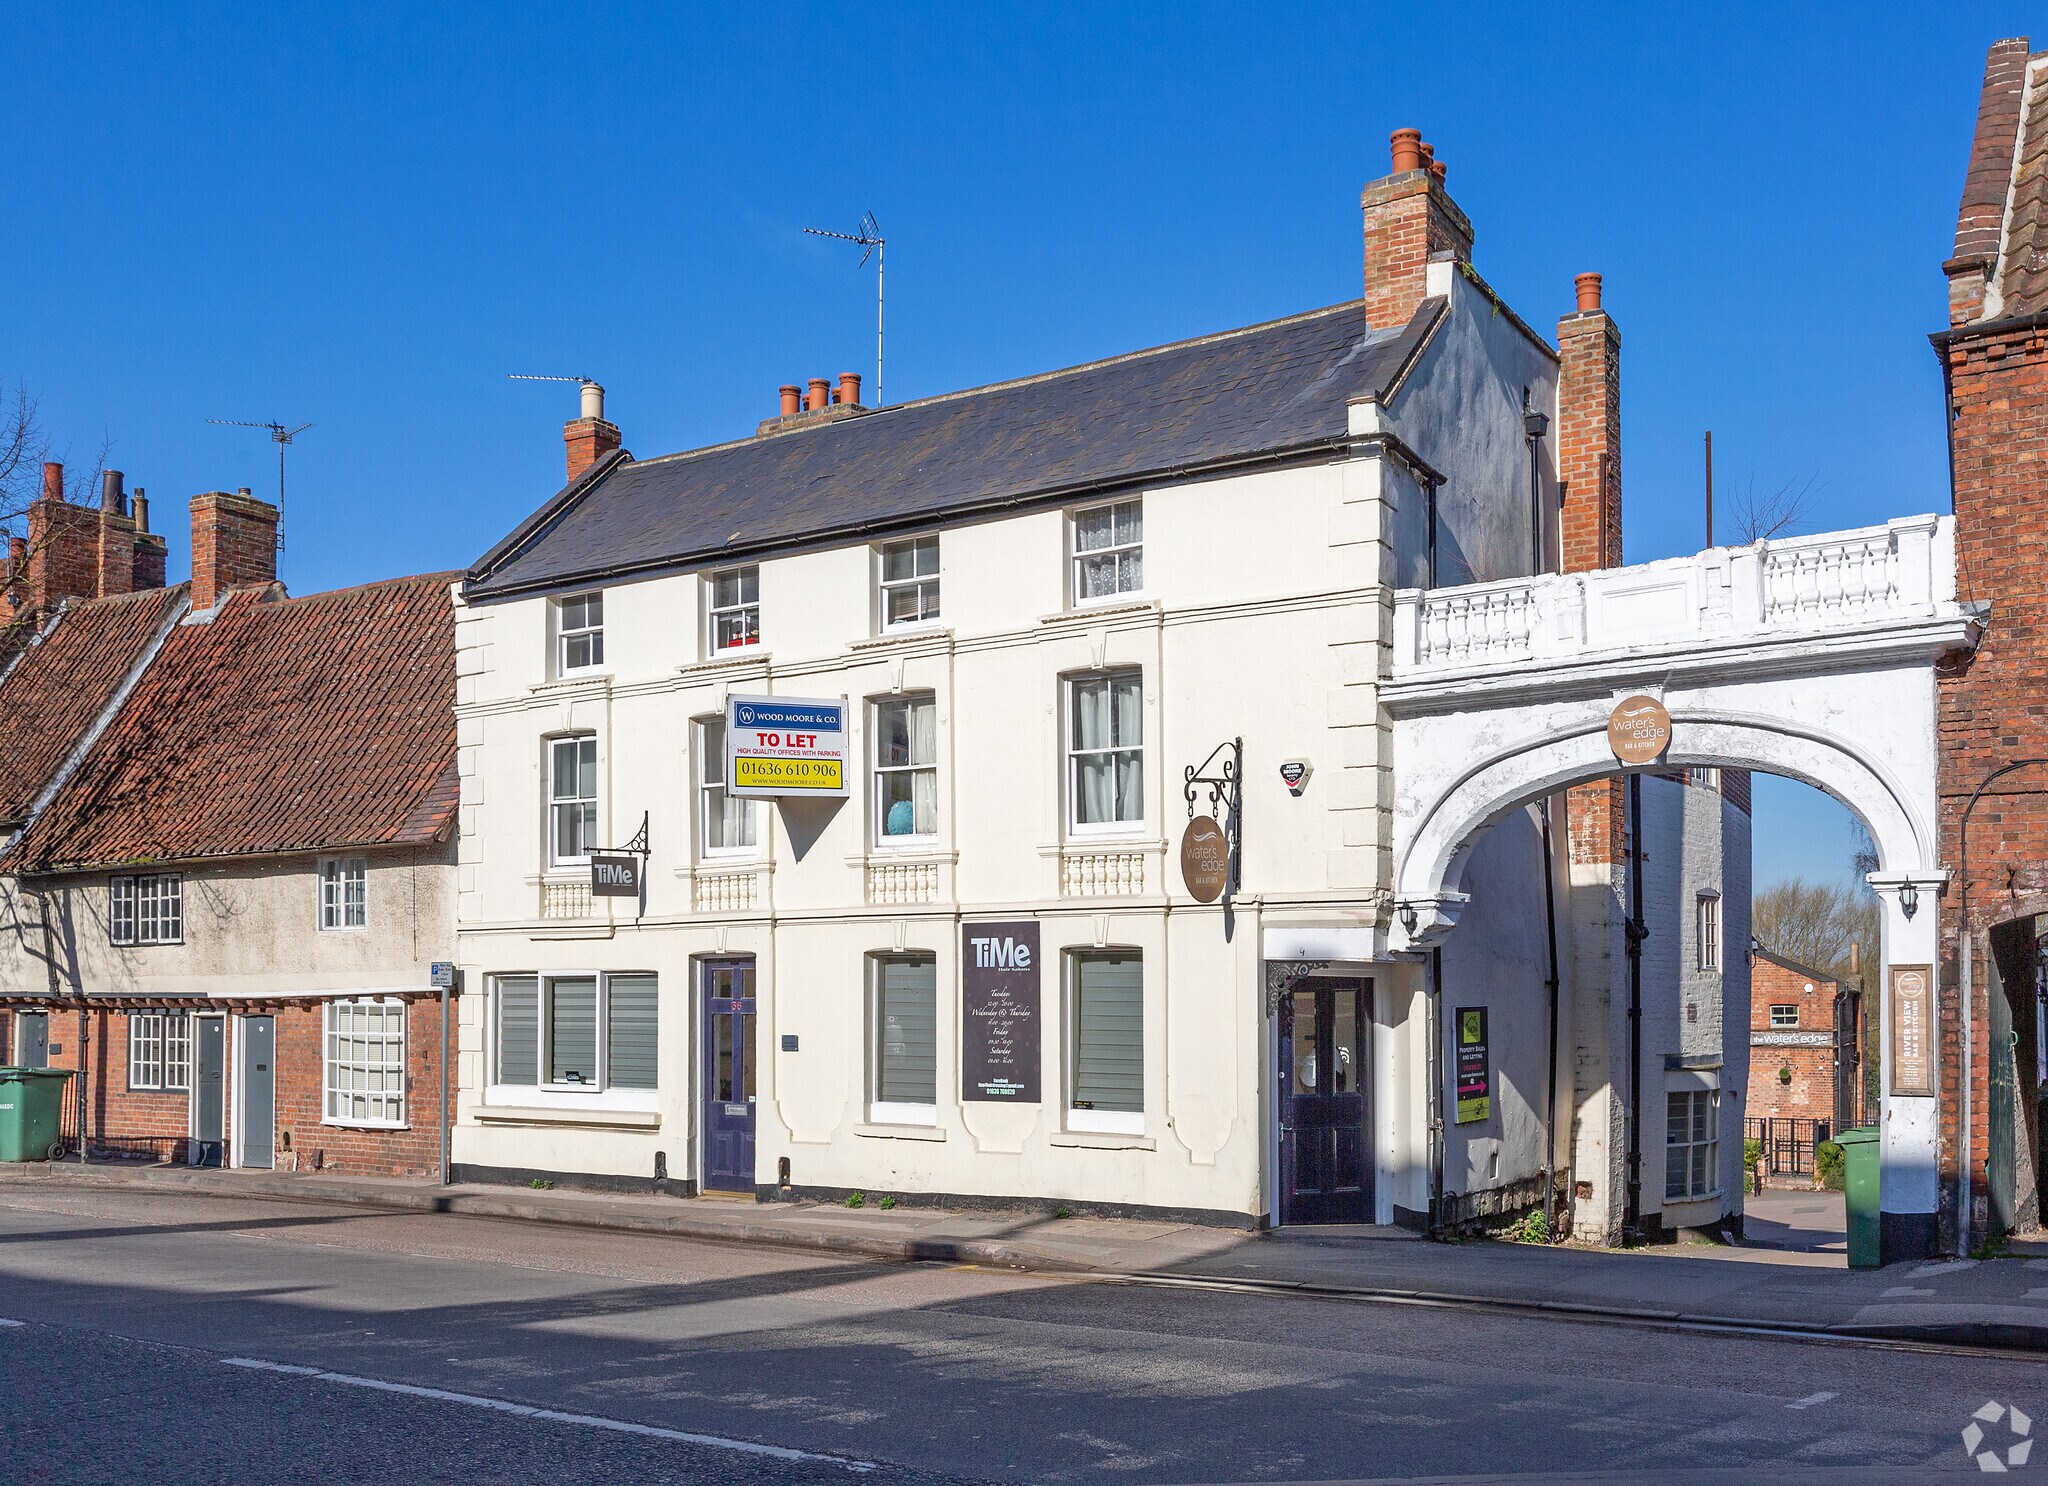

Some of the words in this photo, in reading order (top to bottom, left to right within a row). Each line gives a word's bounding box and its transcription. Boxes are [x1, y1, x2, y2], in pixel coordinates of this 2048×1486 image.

[757, 713, 784, 721] WOOD
[785, 714, 814, 723] MOORE
[815, 714, 823, 723] &
[824, 716, 838, 724] CO.
[1613, 717, 1655, 731] water's
[756, 732, 781, 747] TO
[786, 734, 818, 748] LET
[1633, 726, 1665, 740] edge
[741, 761, 782, 775] 01636
[786, 763, 810, 776] 610
[813, 764, 837, 777] 906
[1186, 844, 1217, 859] water's
[594, 863, 633, 884] TiMe
[1201, 858, 1225, 875] edge
[970, 937, 1032, 968] TiMe
[1009, 1004, 1031, 1021] Thursday
[1903, 1000, 1911, 1026] VIEW
[993, 1024, 1009, 1040] Friday
[1763, 1033, 1799, 1043] water's
[1800, 1034, 1828, 1046] edge
[1903, 1028, 1911, 1057] RIVER
[990, 1044, 1011, 1059] Saturday
